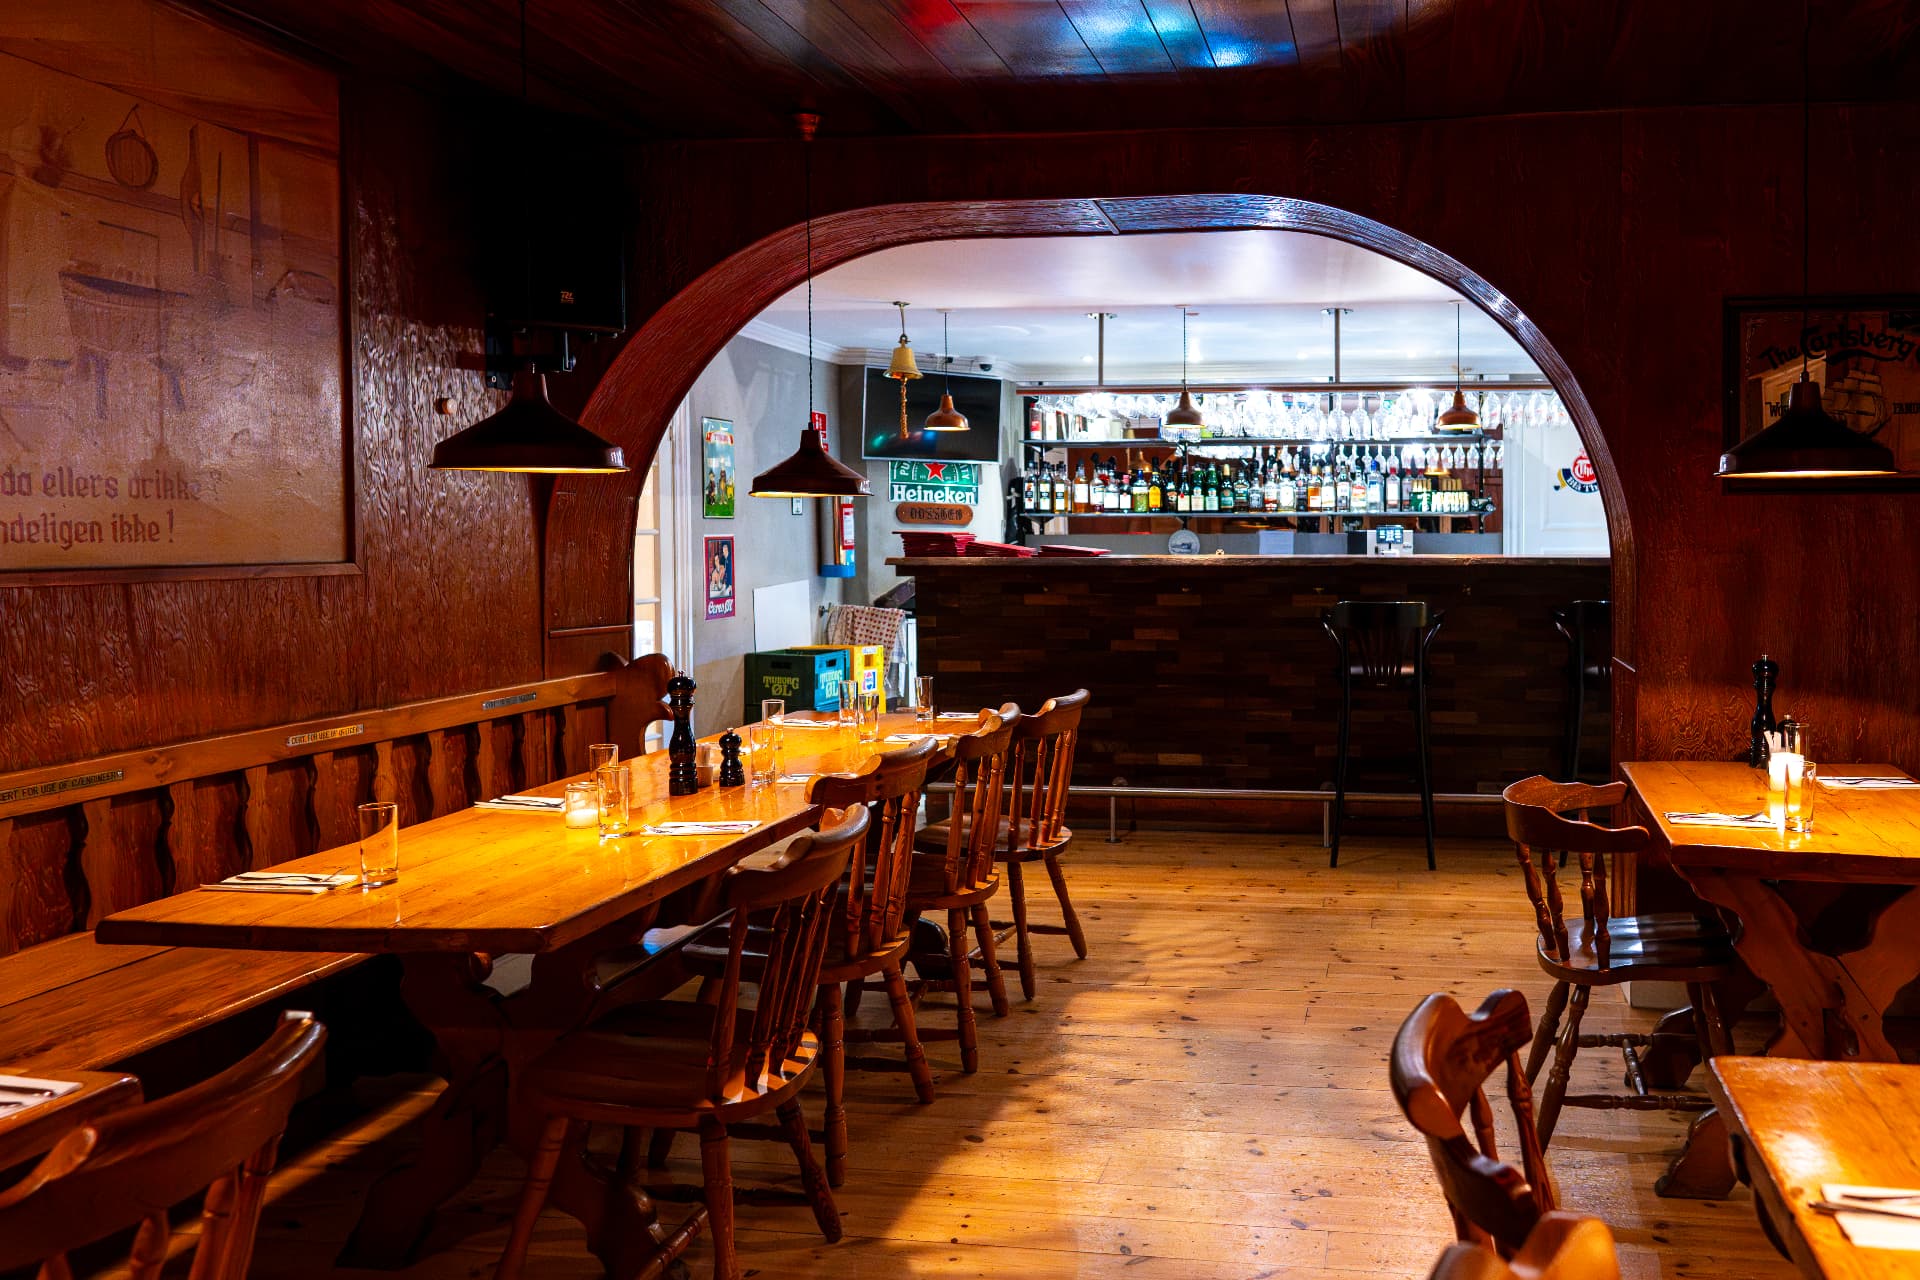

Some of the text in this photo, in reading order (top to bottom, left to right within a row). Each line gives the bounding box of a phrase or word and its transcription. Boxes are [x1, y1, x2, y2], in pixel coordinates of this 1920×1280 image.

[1758, 345, 1799, 369] The
[1800, 323, 1916, 365] Carlsberg
[900, 461, 911, 476] PU
[42, 466, 118, 499] ellers
[892, 484, 977, 504] Heineken
[763, 676, 799, 689] TUBORG
[820, 670, 842, 689] TUBORG
[772, 685, 792, 696] ØL
[826, 681, 839, 699] ØL
[0, 789, 17, 801] ERT
[22, 785, 38, 799] FOR
[41, 782, 56, 794] USE
